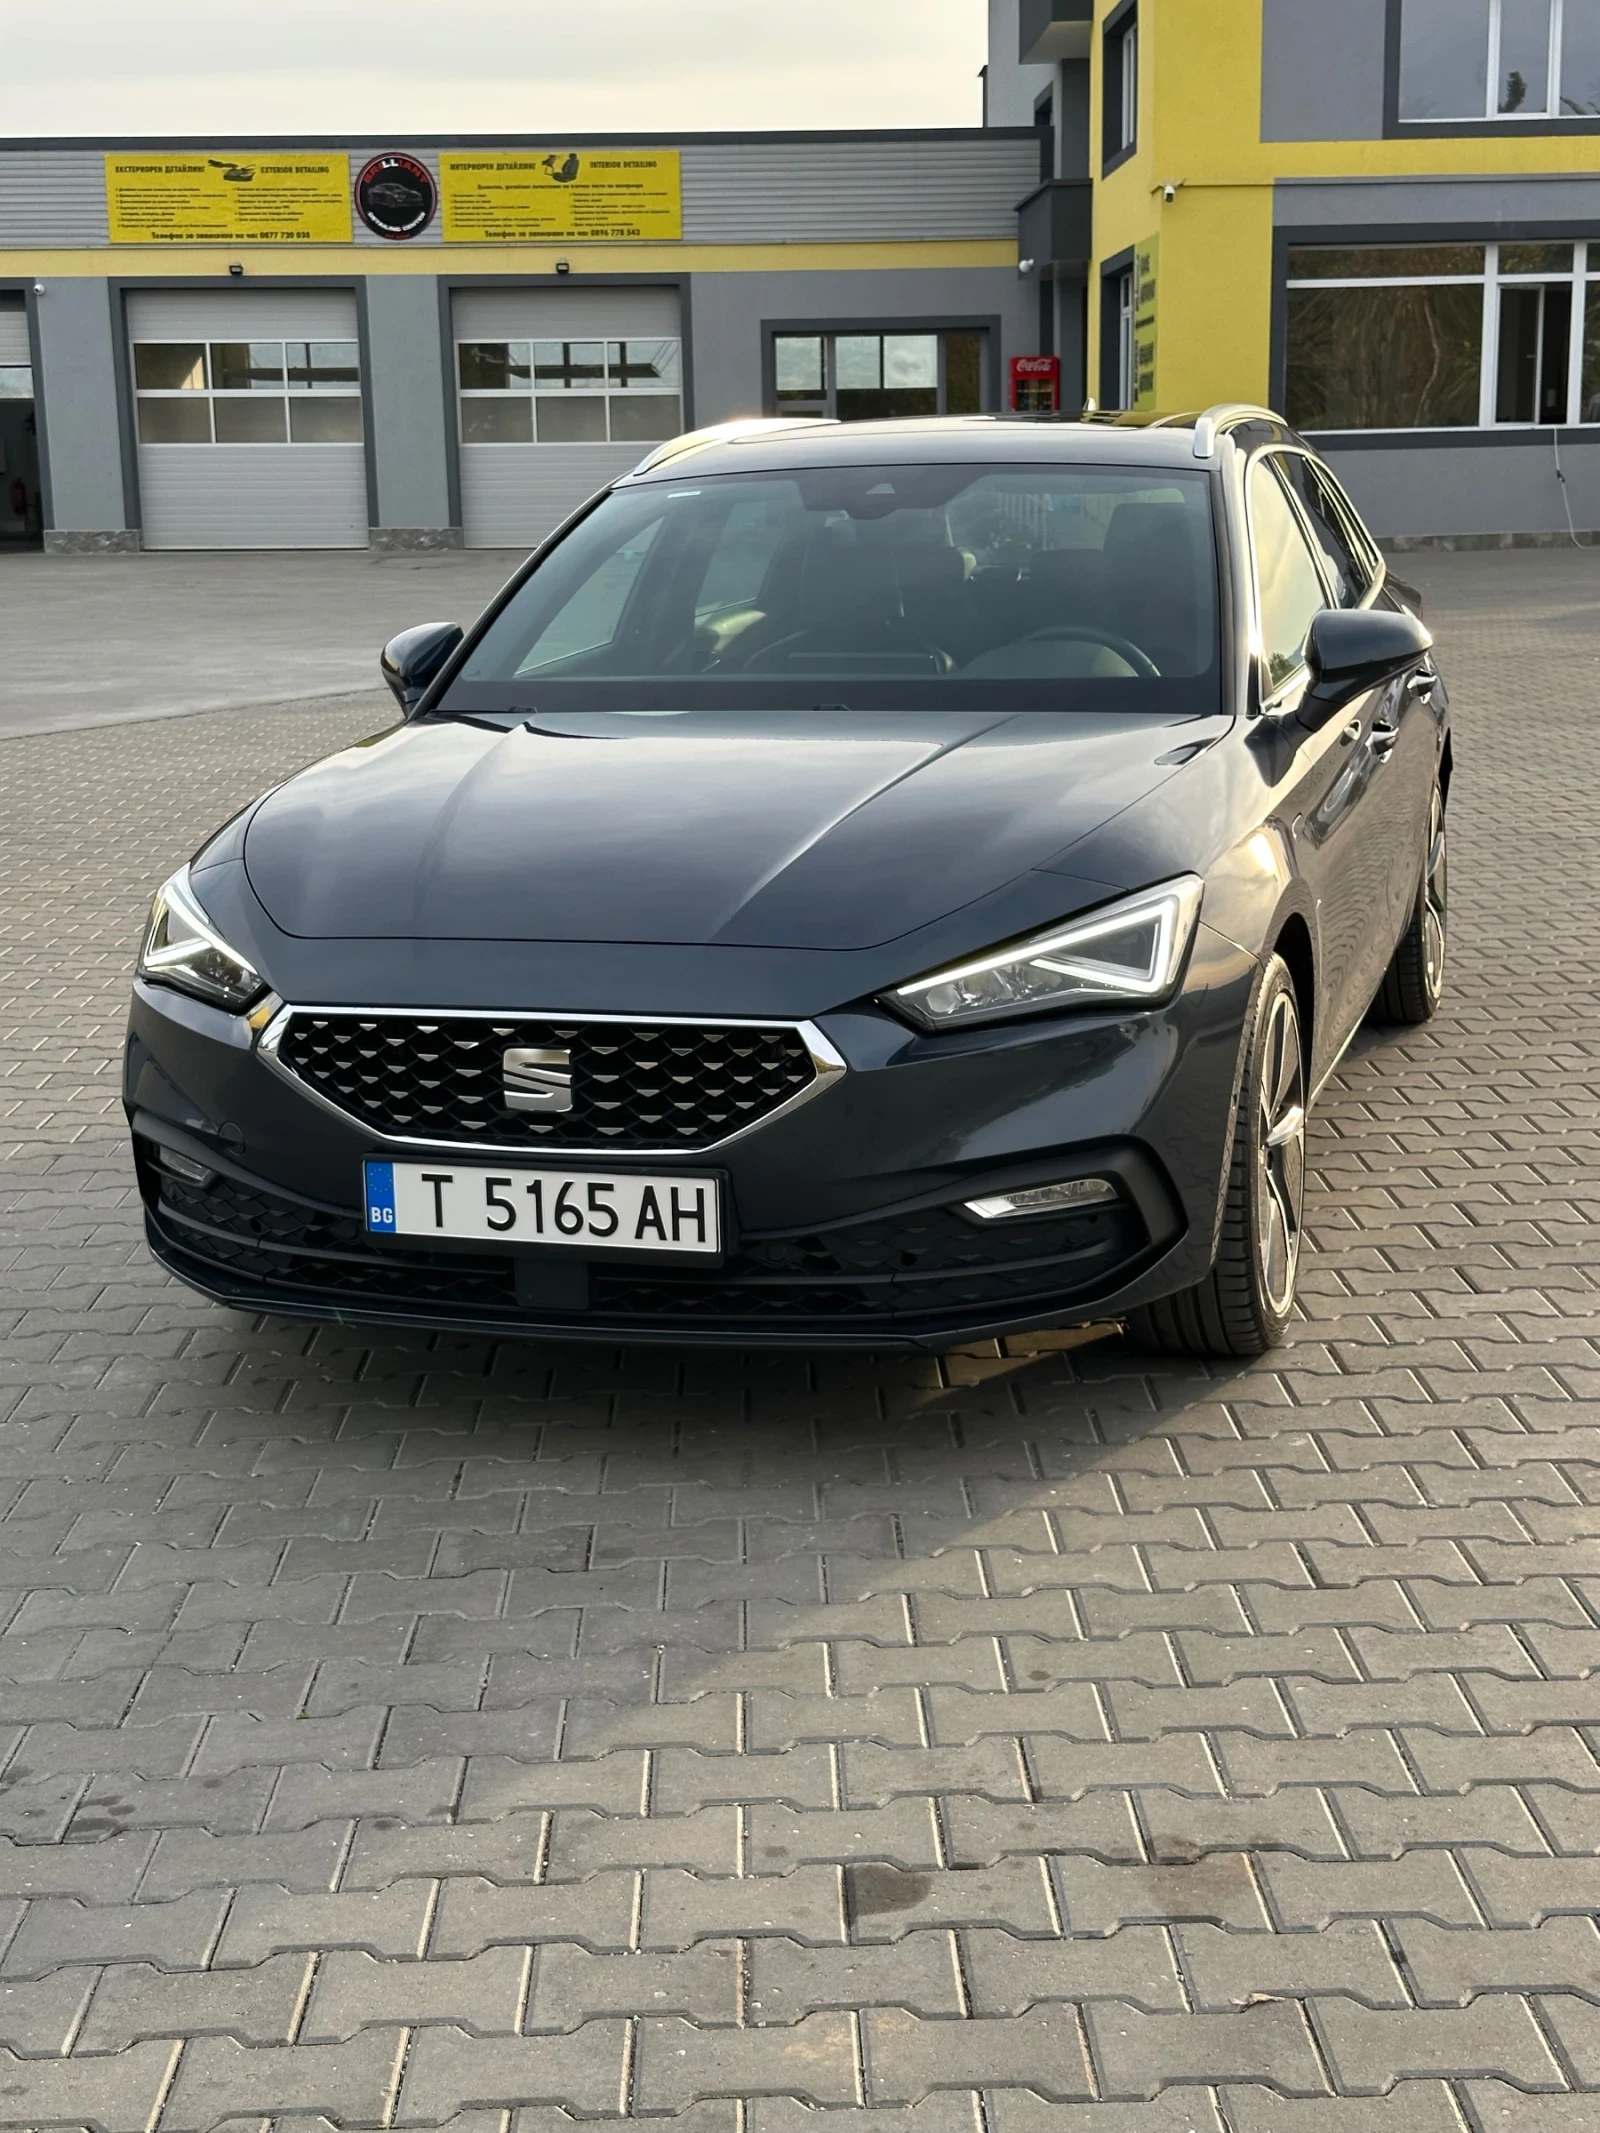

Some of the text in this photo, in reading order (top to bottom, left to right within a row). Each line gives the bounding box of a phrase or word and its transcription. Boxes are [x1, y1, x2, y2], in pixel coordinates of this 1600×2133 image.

[364, 159, 427, 183] BRILLIANT
[371, 1206, 393, 1224] BG
[421, 1172, 706, 1243] T 5165 AH
